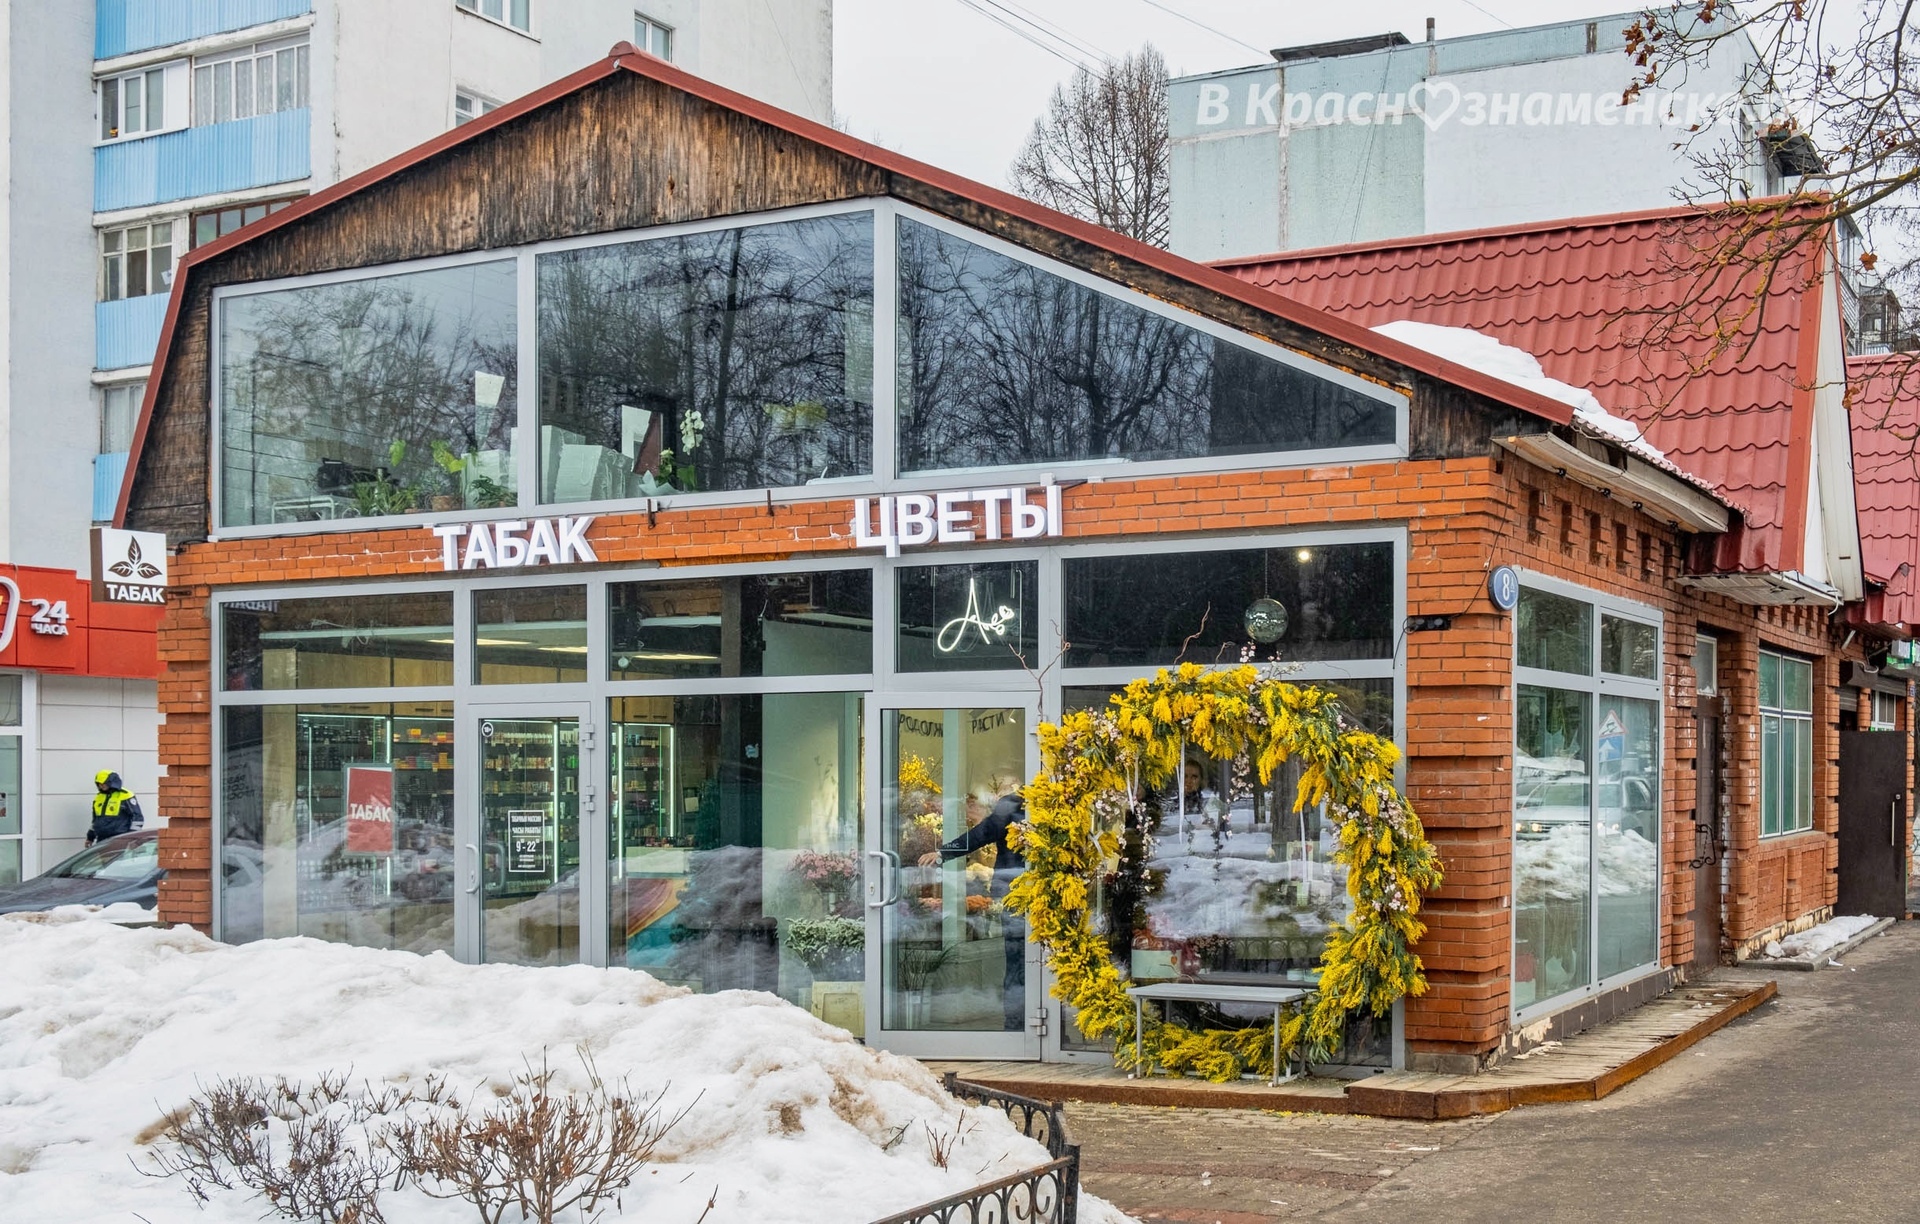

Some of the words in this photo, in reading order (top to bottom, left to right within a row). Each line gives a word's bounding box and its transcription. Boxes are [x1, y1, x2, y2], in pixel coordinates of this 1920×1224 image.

[854, 485, 1062, 558] ЦВЕТЫ
[433, 516, 599, 571] ТАБАК
[106, 583, 165, 603] ТАБАК
[31, 599, 69, 624] 24
[31, 622, 69, 636] ЧАСА
[971, 711, 1005, 734] РАСТИ
[350, 803, 392, 823] ТАБАК
